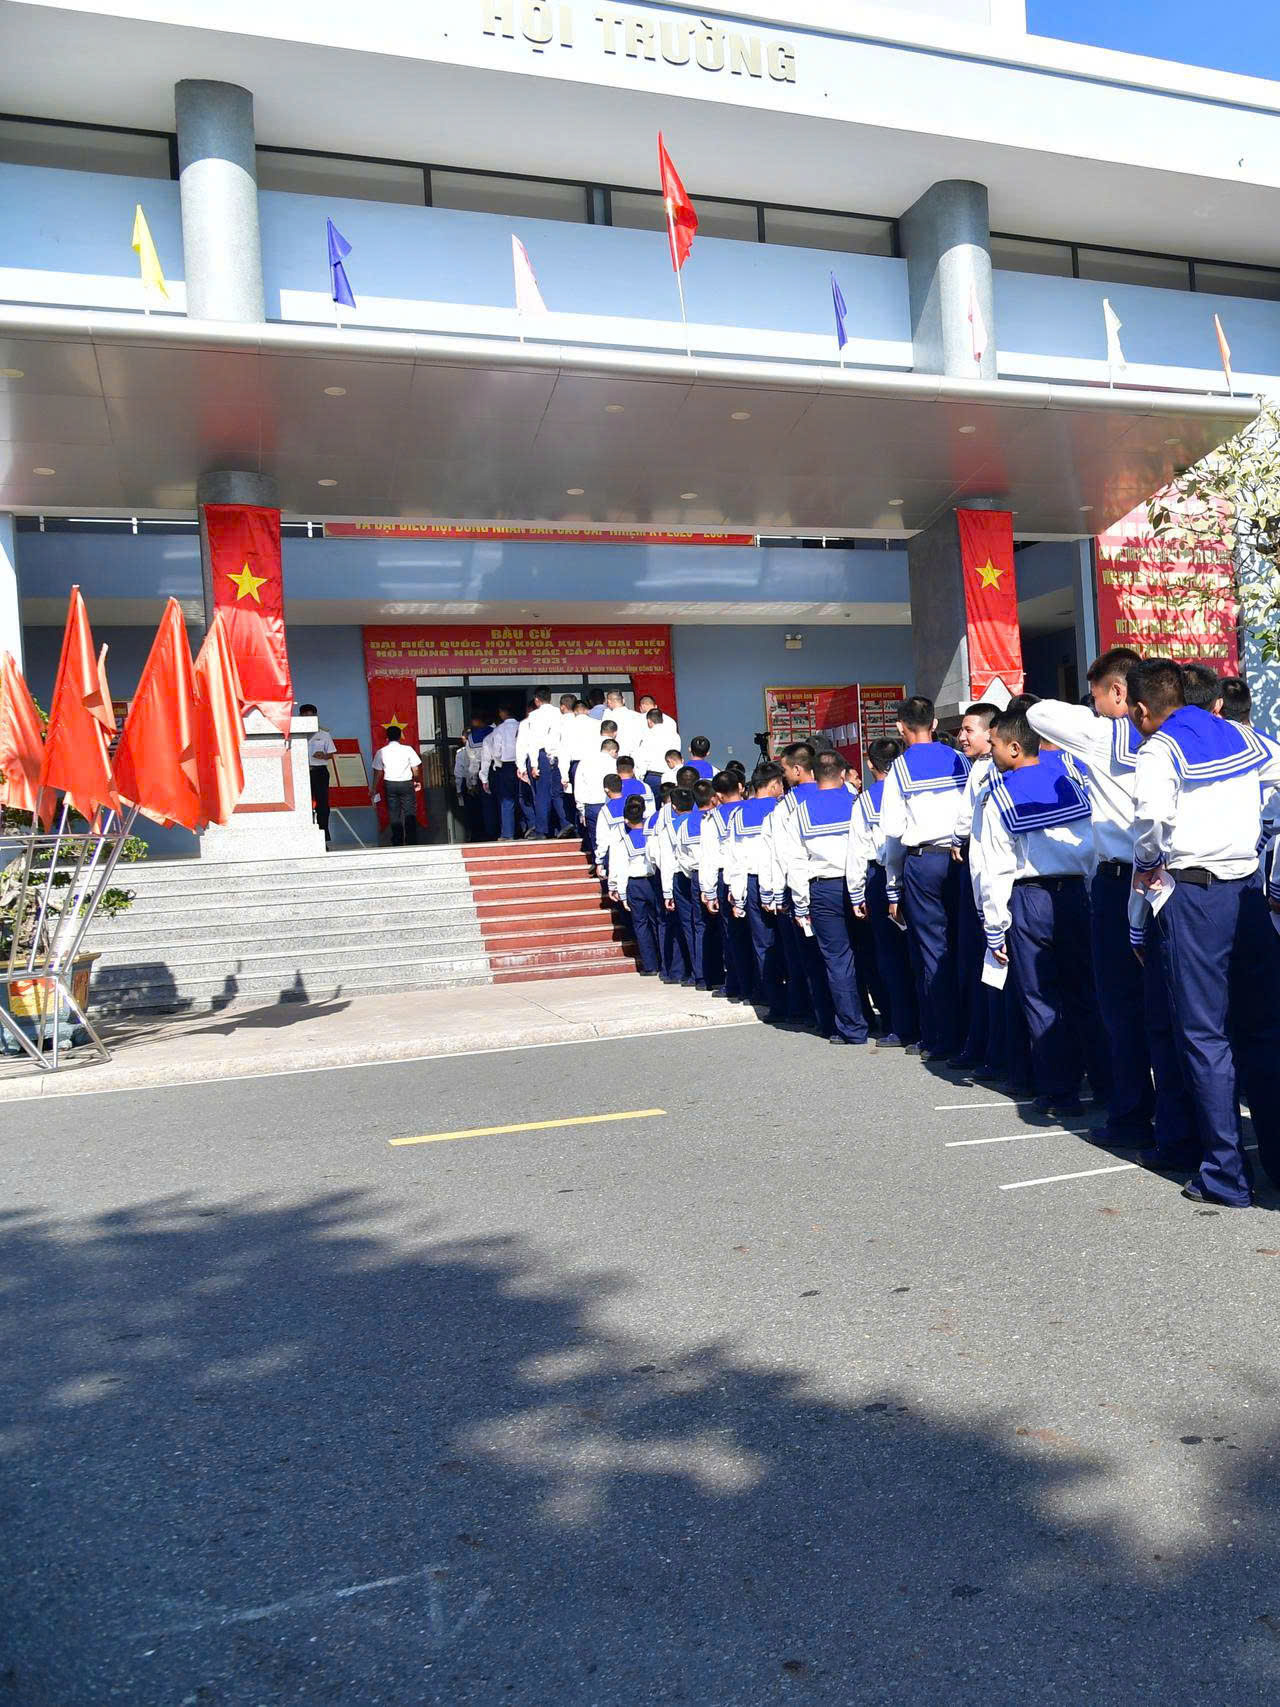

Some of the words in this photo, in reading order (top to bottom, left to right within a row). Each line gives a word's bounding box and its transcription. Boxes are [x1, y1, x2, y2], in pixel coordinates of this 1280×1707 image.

[480, 0, 573, 54] HỘI
[594, 12, 797, 84] TRƯỜNG
[491, 627, 523, 640] BẦU
[529, 627, 552, 640] CỬ
[440, 639, 481, 648] QUỐC
[558, 640, 580, 648] XVI
[585, 638, 603, 648] VÀ
[454, 648, 494, 656] NHÂN
[532, 647, 561, 656] CÁC
